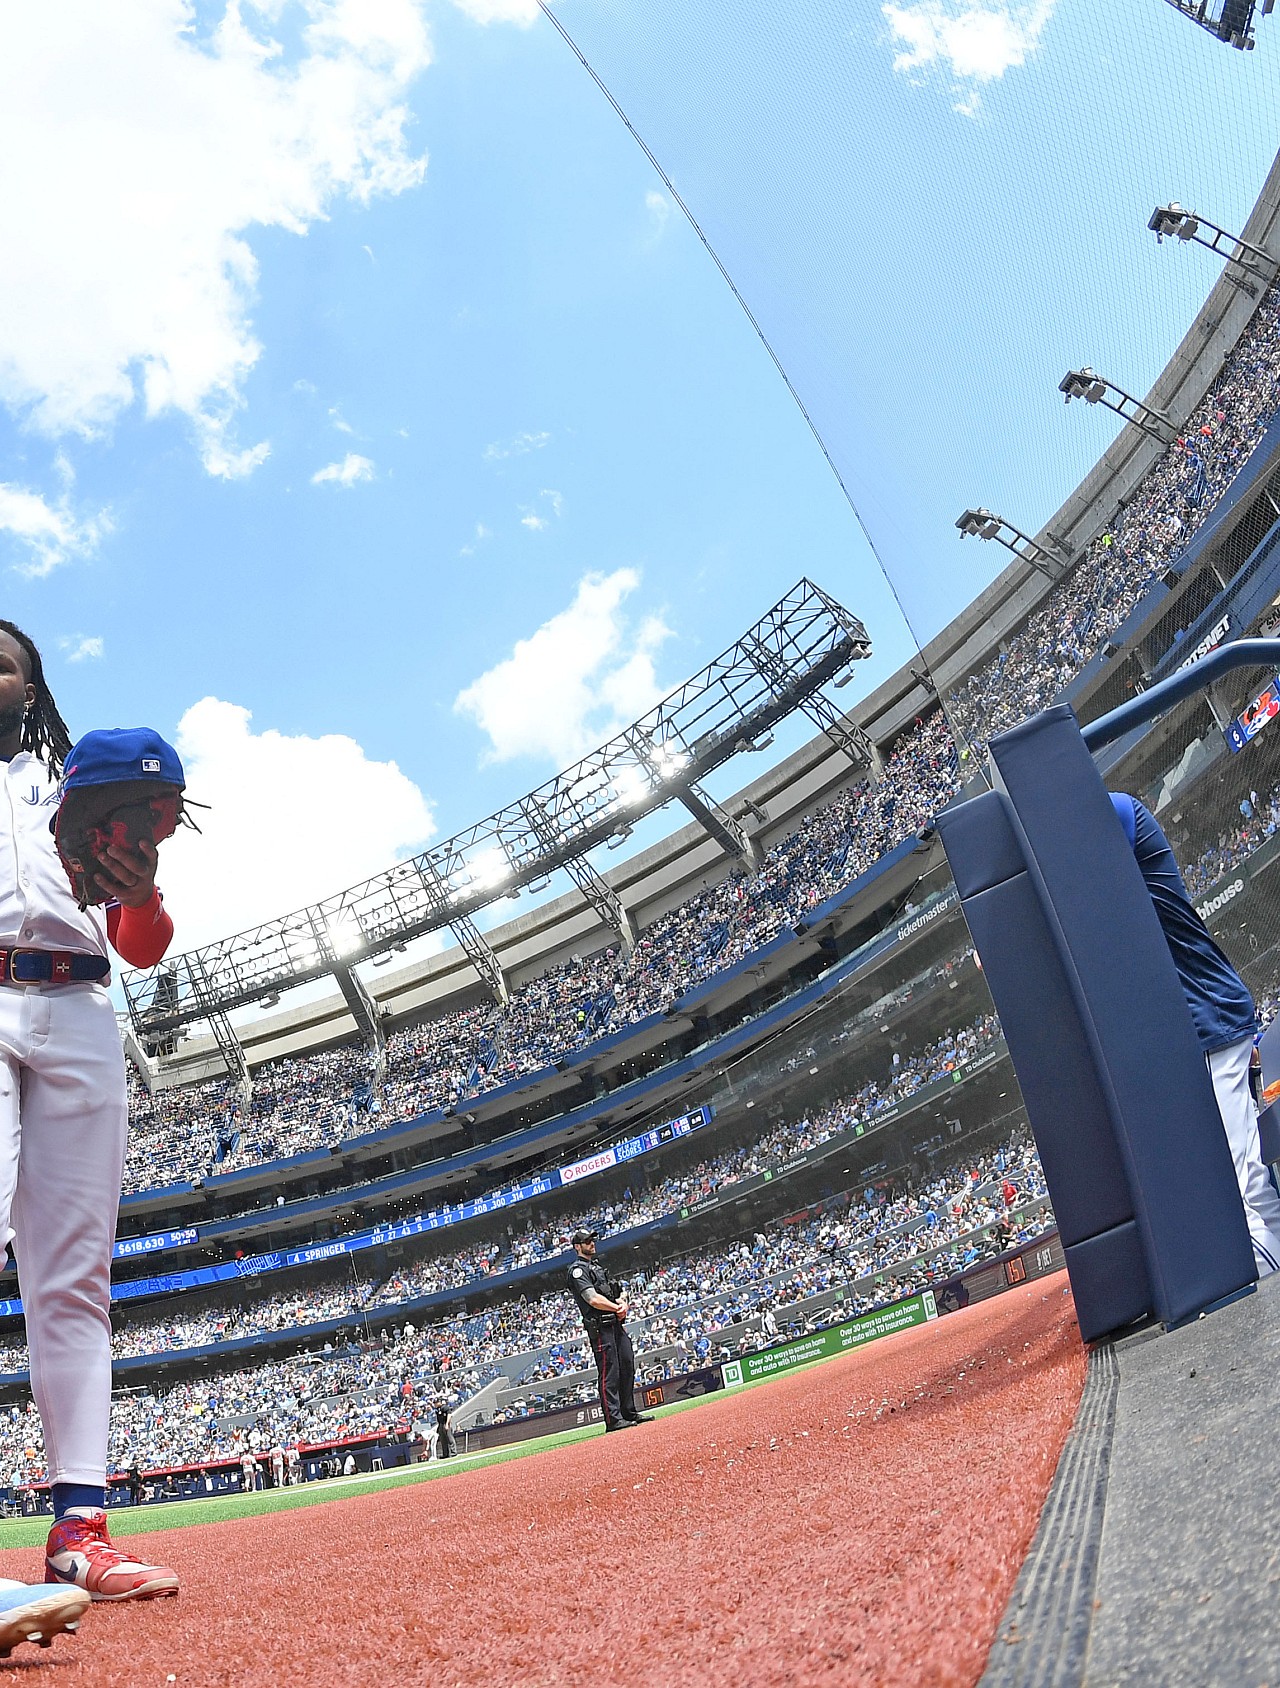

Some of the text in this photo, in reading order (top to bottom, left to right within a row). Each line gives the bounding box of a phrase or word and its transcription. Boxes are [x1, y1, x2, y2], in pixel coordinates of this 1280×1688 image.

[21, 785, 63, 807] JA
[1195, 879, 1244, 920] bhouse
[897, 898, 949, 941] ticketmaster
[972, 1051, 996, 1069] Clubhouse
[874, 1108, 899, 1124] Clubhouse
[617, 1144, 642, 1160] SCORES
[575, 1155, 612, 1176] ROGERS
[783, 1157, 807, 1171] Clubhouse
[697, 1198, 719, 1210] Clubhouse
[294, 1254, 300, 1264] 4
[305, 1243, 346, 1261] SPRINGER
[371, 1234, 384, 1245] 207
[388, 1231, 396, 1240] 27
[401, 1227, 411, 1236] 43
[430, 1219, 438, 1228] 13
[444, 1214, 453, 1224] 27
[472, 1204, 488, 1216] .208
[490, 1198, 506, 1210] .300
[510, 1191, 524, 1203] .314
[531, 1183, 546, 1196] .614
[840, 1328, 853, 1337] Over
[853, 1324, 861, 1332] 30
[861, 1320, 875, 1330] ways
[881, 1314, 895, 1322] save
[902, 1303, 919, 1315] home
[842, 1315, 915, 1346] and auto with TD Insurance.
[748, 1358, 764, 1367] Over
[764, 1354, 773, 1363] 30
[774, 1351, 788, 1360] ways
[812, 1337, 826, 1348] home
[750, 1366, 762, 1375] and
[763, 1362, 777, 1371] auto
[777, 1358, 790, 1367] with
[790, 1354, 797, 1363] TD
[646, 1388, 664, 1406] 157
[591, 1406, 604, 1419] BE
